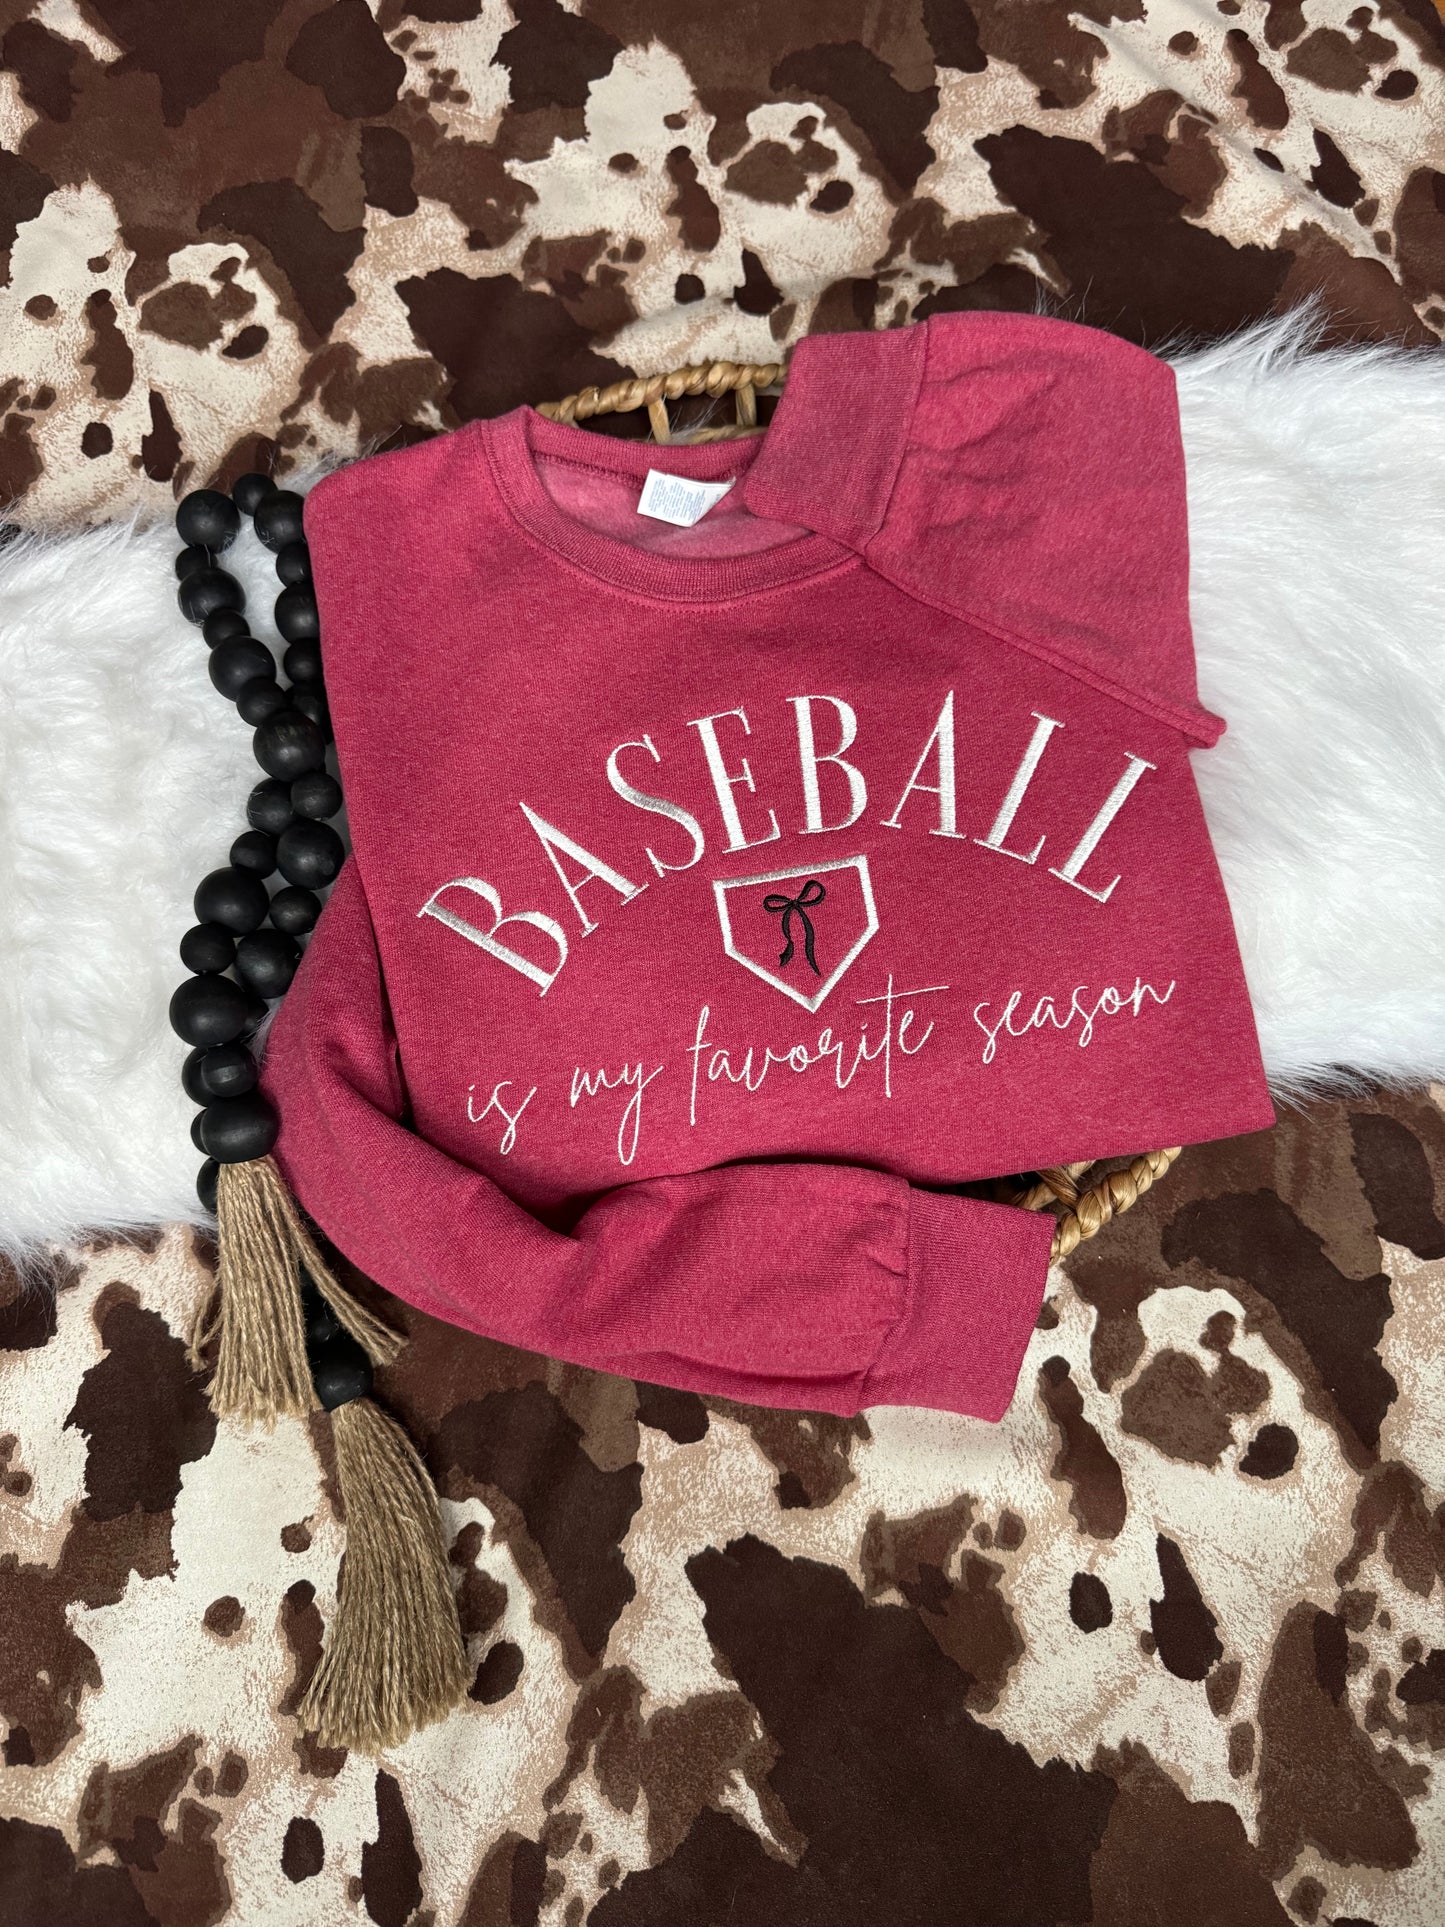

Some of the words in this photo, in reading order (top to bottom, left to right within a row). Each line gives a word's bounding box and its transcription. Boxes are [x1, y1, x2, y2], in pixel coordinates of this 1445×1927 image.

[417, 689, 1158, 997] BASEBALL
[467, 1079, 536, 1155] is
[570, 1064, 664, 1165] my
[686, 973, 950, 1126] favorite
[973, 976, 1176, 1064] season
